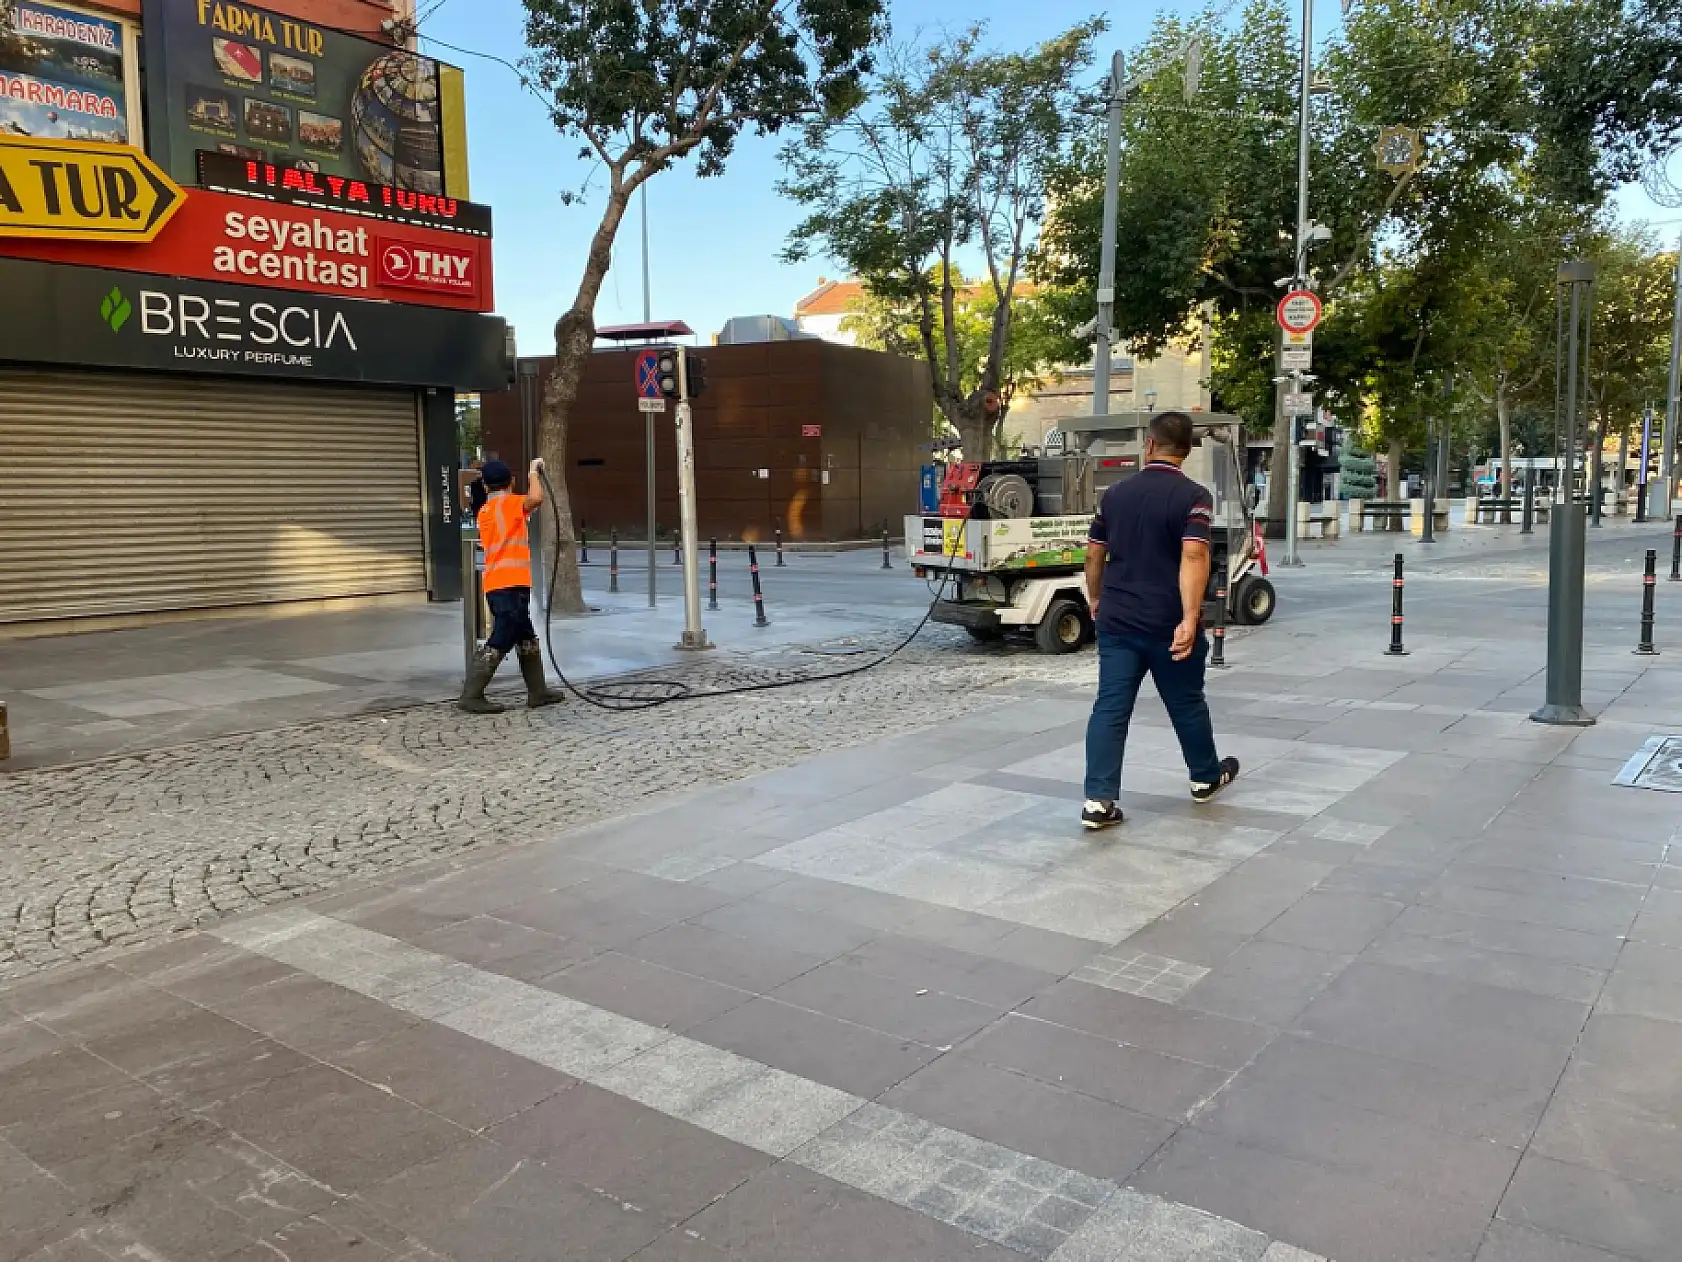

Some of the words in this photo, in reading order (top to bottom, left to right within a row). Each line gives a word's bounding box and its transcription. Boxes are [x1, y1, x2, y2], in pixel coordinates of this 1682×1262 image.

[196, 0, 277, 44] FARMA
[281, 20, 324, 58] TUR
[29, 160, 141, 220] TUR
[224, 211, 369, 257] seyahat
[213, 245, 368, 289] acentası
[414, 249, 470, 279] THY
[139, 290, 358, 351] BRESCIA
[173, 345, 240, 362] LUXURY
[244, 350, 313, 367] PERFUME
